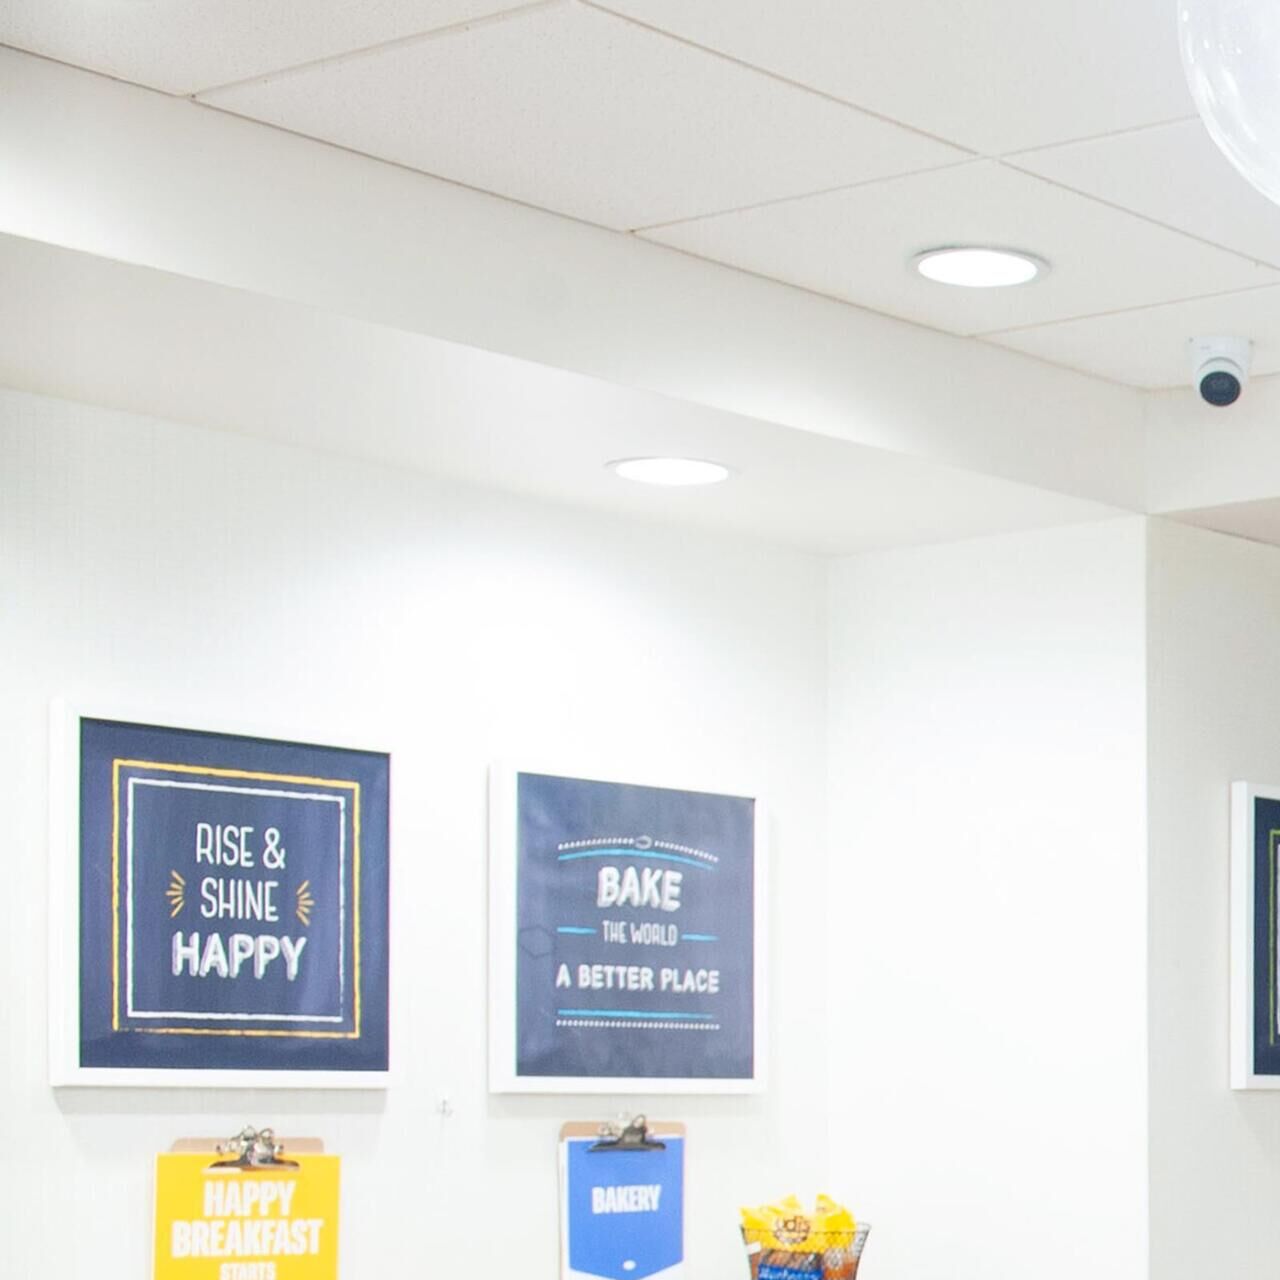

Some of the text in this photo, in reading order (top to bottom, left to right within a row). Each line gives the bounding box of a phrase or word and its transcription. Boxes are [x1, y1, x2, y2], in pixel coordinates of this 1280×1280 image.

[196, 823, 286, 869] RISE &
[201, 877, 279, 922] SHINE
[597, 866, 683, 912] BAKE
[602, 920, 678, 946] THE WORLD
[172, 931, 307, 981] HAPPY
[556, 963, 720, 993] A BETTER PLACE
[204, 1180, 296, 1217] HAPPY
[592, 1184, 662, 1215] BAKERY
[171, 1219, 324, 1259] BREAKFAST
